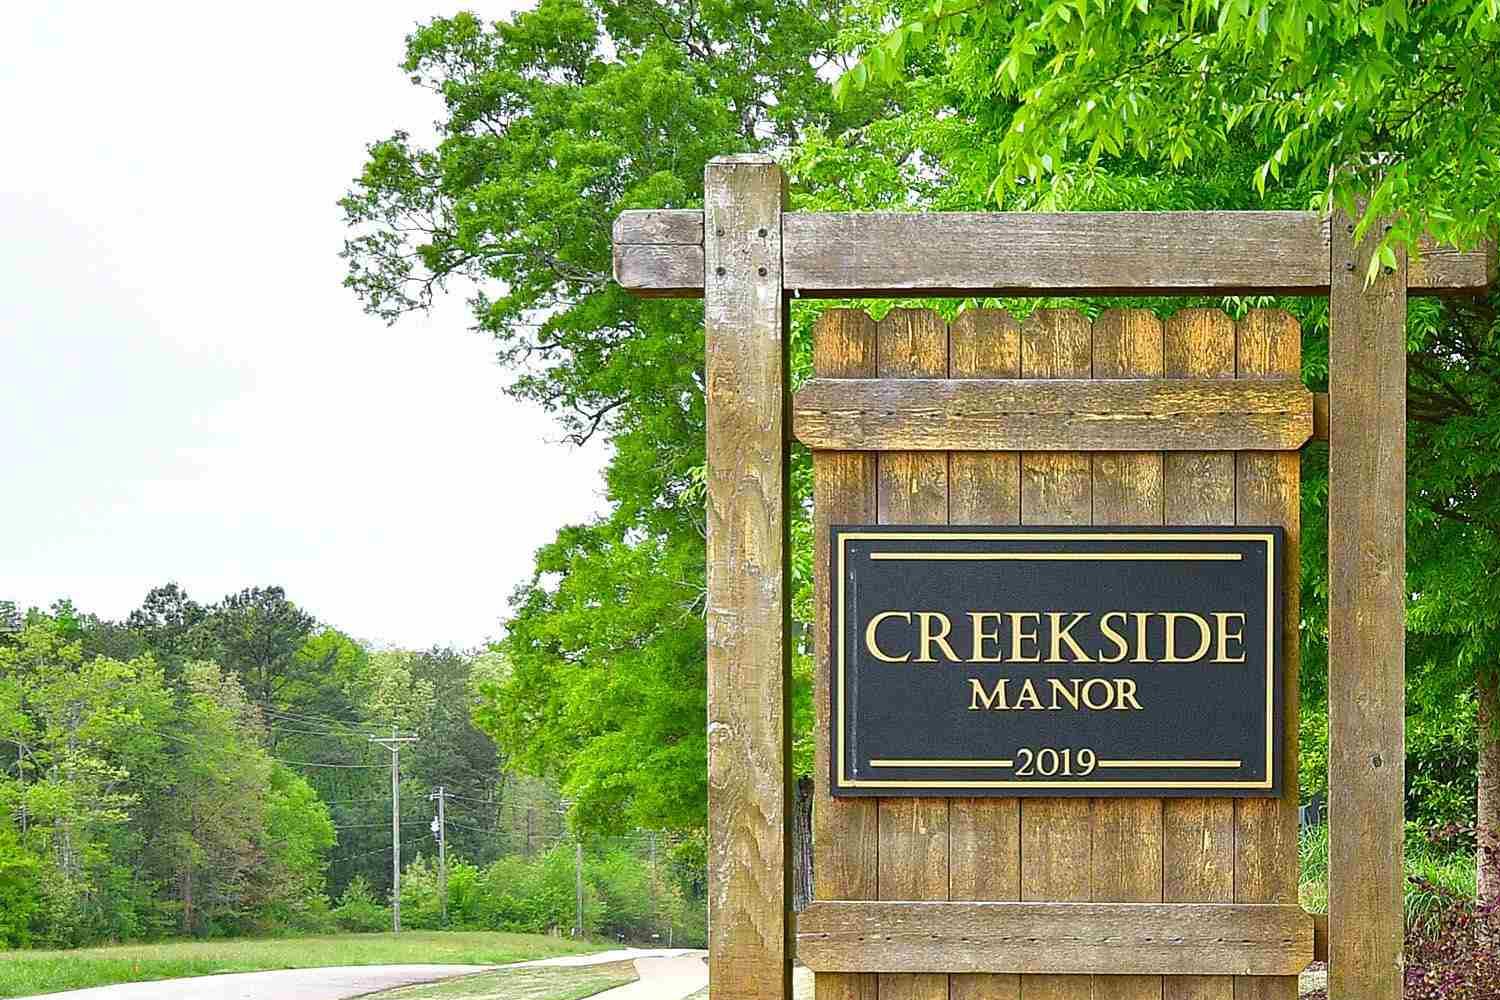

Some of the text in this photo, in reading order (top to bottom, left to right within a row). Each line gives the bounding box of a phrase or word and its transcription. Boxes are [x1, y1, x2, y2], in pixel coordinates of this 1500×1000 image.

[865, 611, 1247, 663] CREEKSIDE
[967, 678, 1144, 711] MANOR
[1015, 748, 1097, 777] 2019
